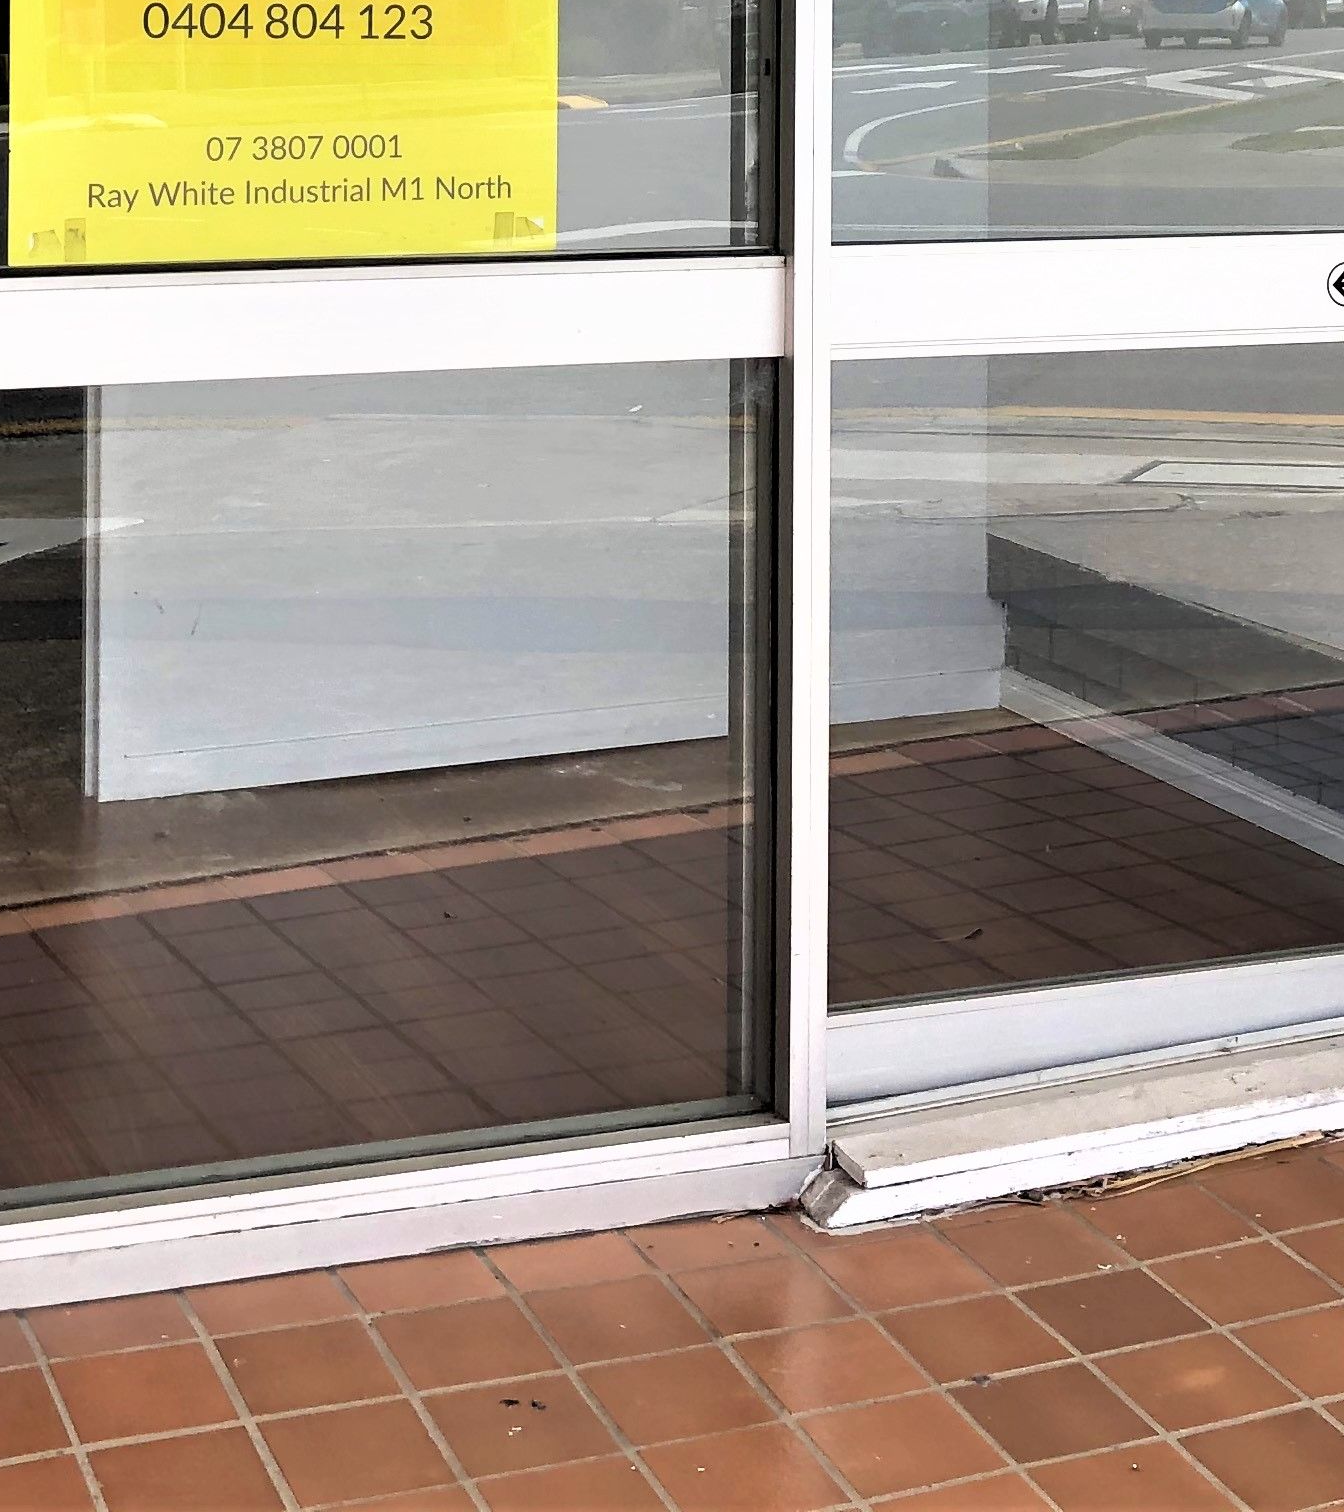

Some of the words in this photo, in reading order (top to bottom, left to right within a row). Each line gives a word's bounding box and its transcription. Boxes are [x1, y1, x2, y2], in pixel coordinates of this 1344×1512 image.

[143, 2, 254, 40] 0404
[265, 3, 345, 40] 804
[359, 3, 434, 40] 123
[206, 136, 243, 162] 07
[252, 135, 324, 162] 3807
[332, 134, 403, 160] 0001
[88, 183, 139, 213] Ray
[148, 180, 235, 207] White
[246, 177, 372, 205] Industrial
[382, 176, 425, 202] M1
[435, 174, 512, 201] North
